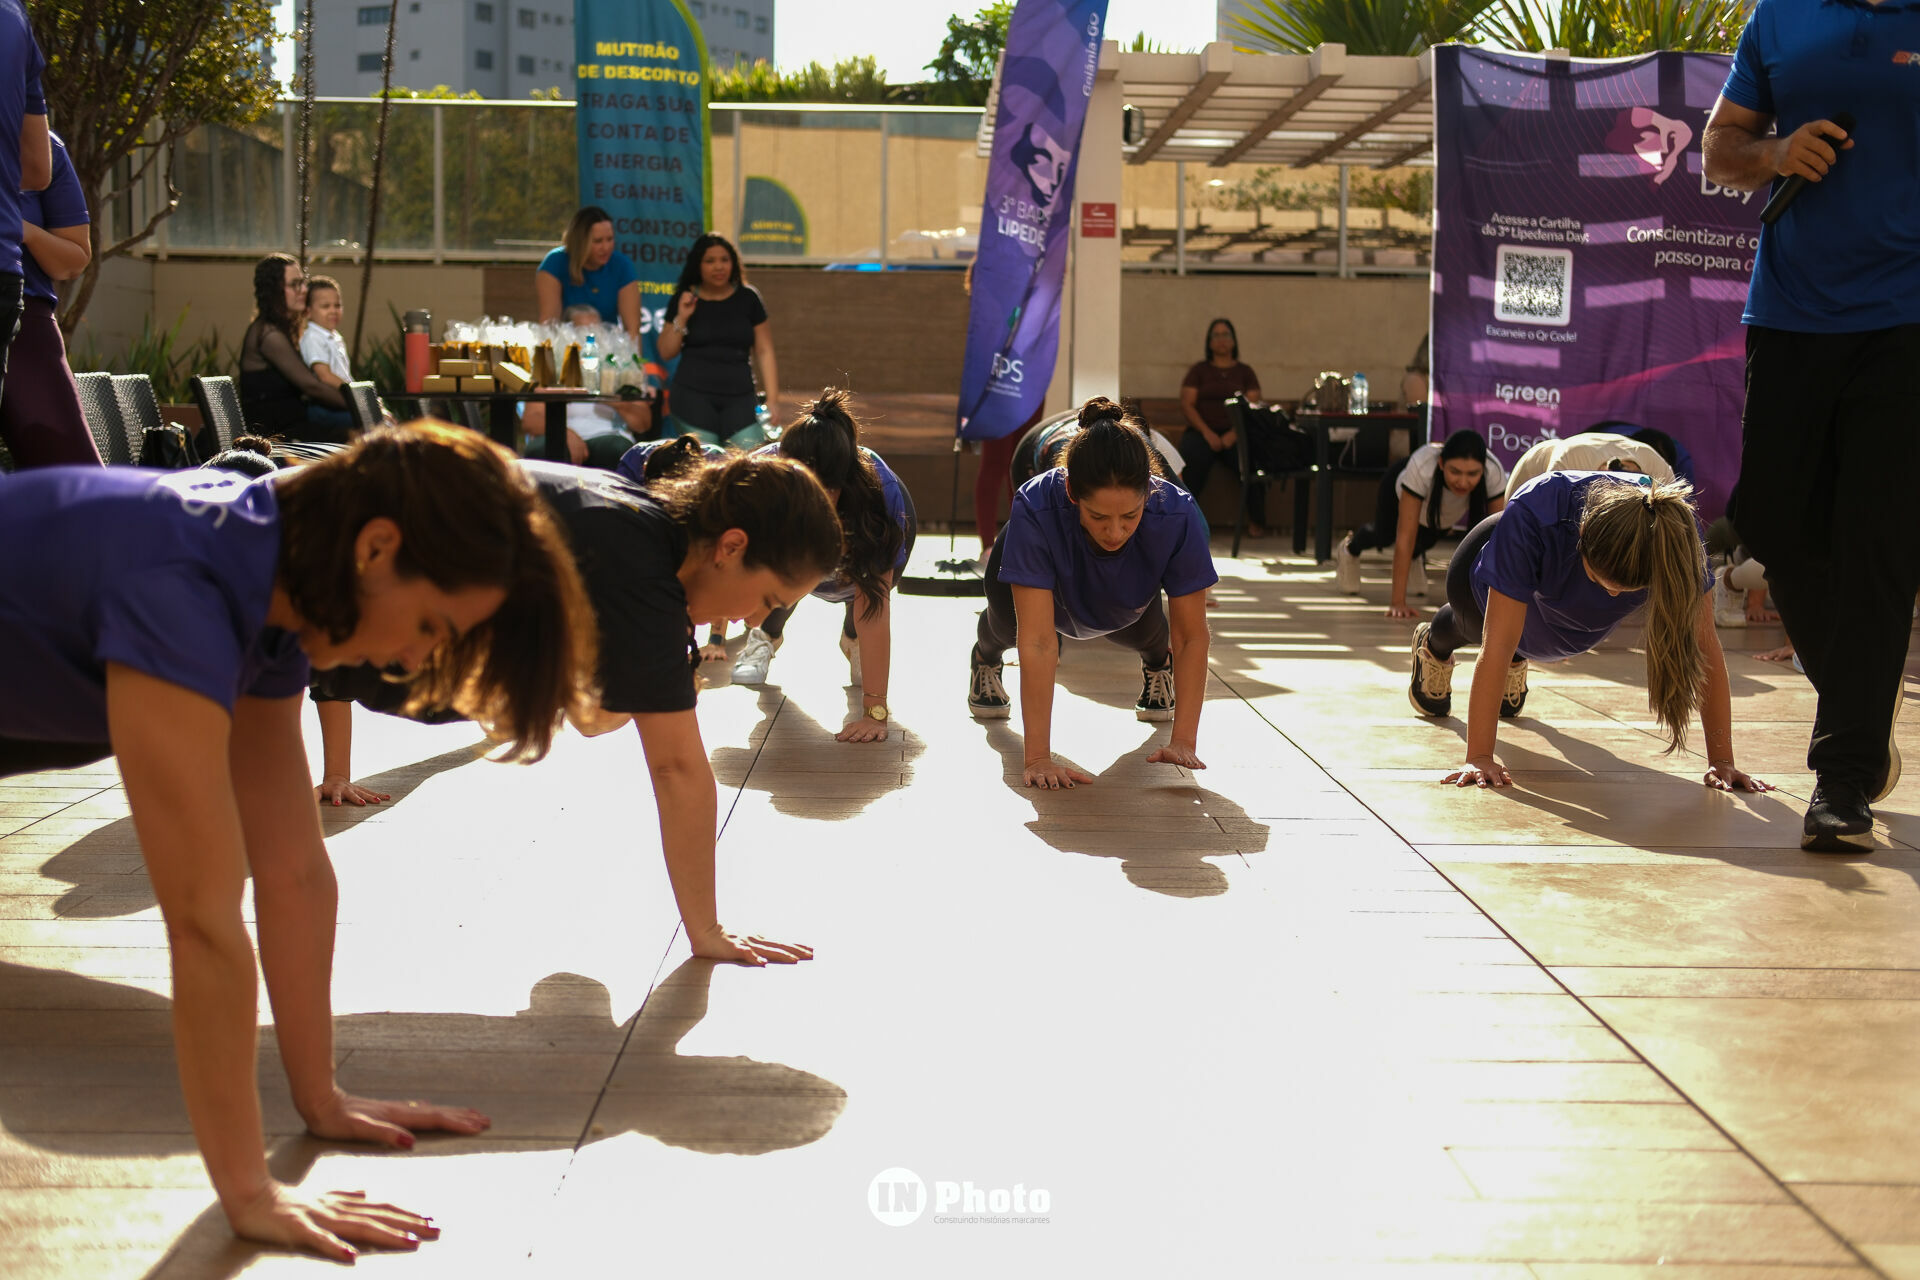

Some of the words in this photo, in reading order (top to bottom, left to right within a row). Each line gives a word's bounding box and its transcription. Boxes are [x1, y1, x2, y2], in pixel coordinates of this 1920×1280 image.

[596, 41, 679, 60] MUTIRÃO
[578, 65, 599, 78] DE
[604, 65, 699, 85] DESCONTO
[581, 93, 649, 111] TRAGA
[657, 96, 695, 114] SUA
[587, 122, 657, 141] CONTA
[663, 126, 689, 143] DE
[594, 153, 682, 172] ENERGIA
[595, 183, 603, 198] E
[612, 184, 683, 203] GANHE
[616, 218, 701, 239] CONTOS
[1491, 212, 1529, 226] Acesse
[1530, 217, 1537, 227] a
[1539, 216, 1580, 230] Cartilha
[1481, 223, 1496, 236] do
[1511, 227, 1564, 241] Lipedema
[1626, 225, 1733, 247] Conscientizar
[1736, 233, 1746, 249] é
[1654, 250, 1702, 268] passo
[1704, 255, 1741, 272] para
[1486, 324, 1526, 340] Escaneie
[1528, 331, 1534, 340] o
[1551, 331, 1577, 343] Code!
